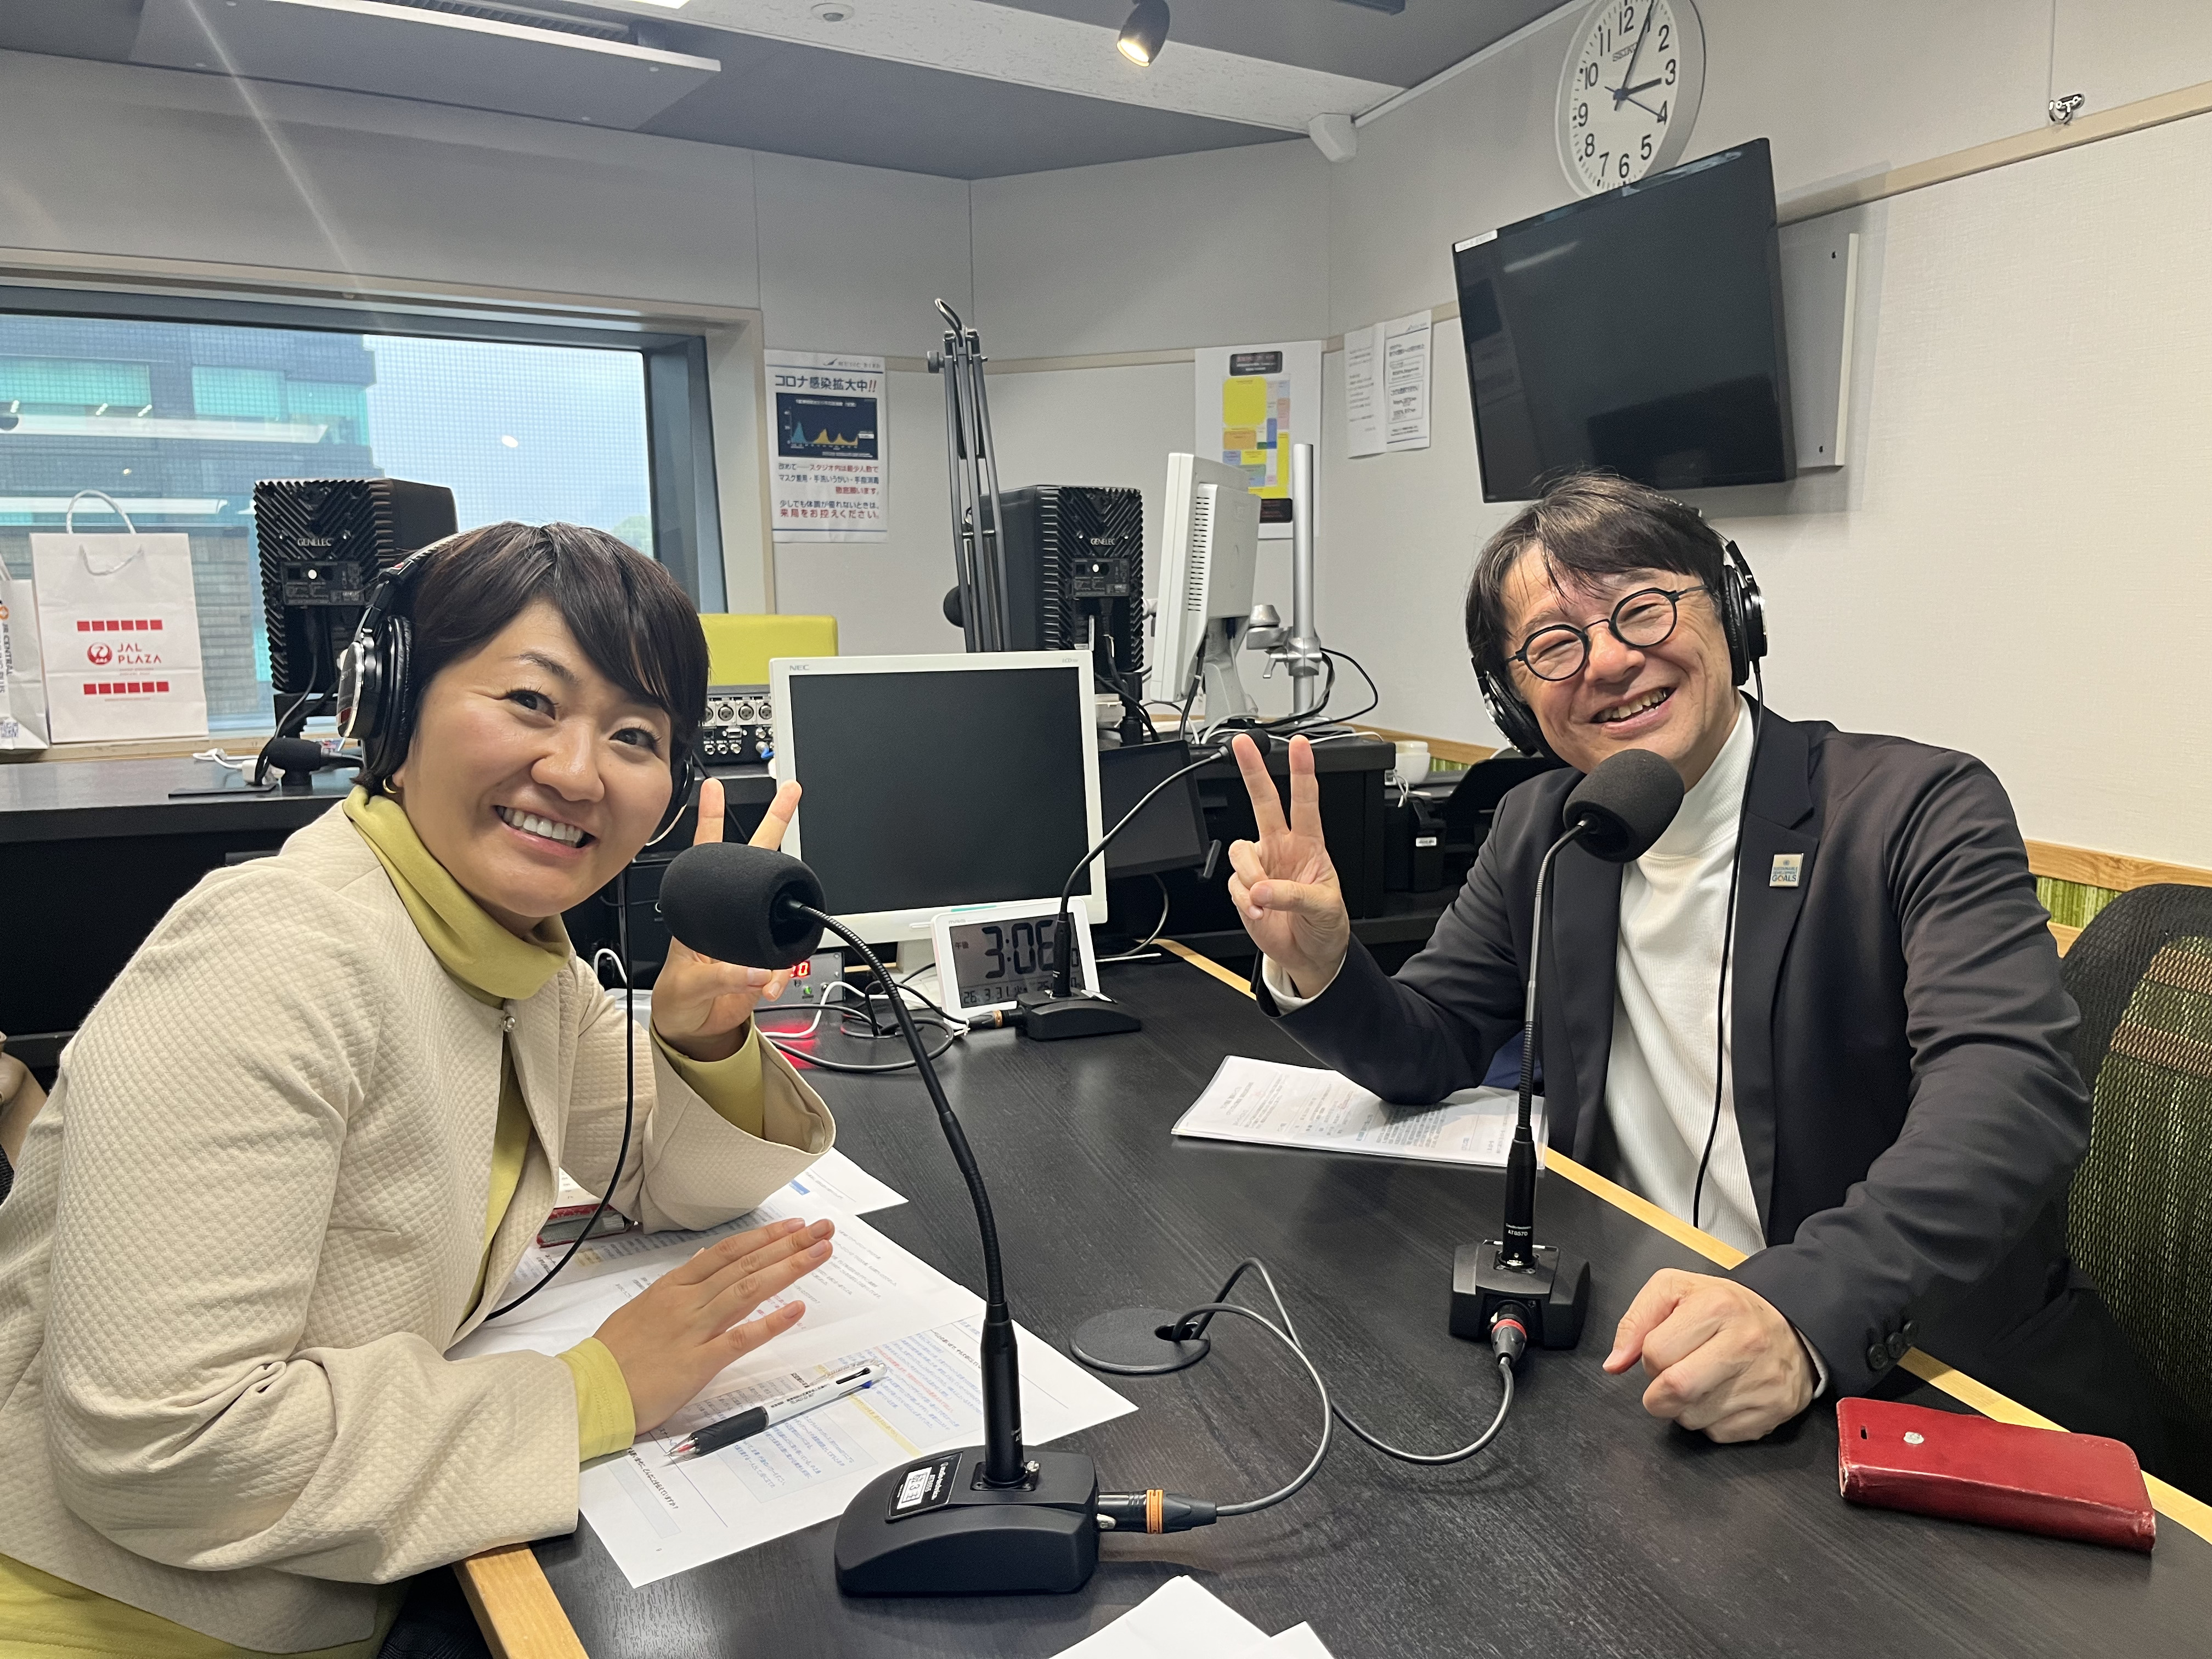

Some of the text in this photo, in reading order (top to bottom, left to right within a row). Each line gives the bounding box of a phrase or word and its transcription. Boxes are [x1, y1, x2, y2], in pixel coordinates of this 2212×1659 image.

[1619, 6, 1634, 36] 12
[1600, 29, 1611, 57] 11
[1658, 25, 1669, 53] 2
[1584, 62, 1599, 90] 10
[1665, 59, 1677, 86] 3
[1578, 103, 1588, 127] 9
[1657, 100, 1668, 125] 4
[1584, 133, 1595, 157] 8
[1640, 134, 1652, 160] 5
[1599, 151, 1610, 177] 7
[1619, 153, 1629, 178] 6
[117, 642, 142, 653] JAL
[118, 653, 162, 664] PLAZA
[1771, 874, 1797, 882] GOALS
